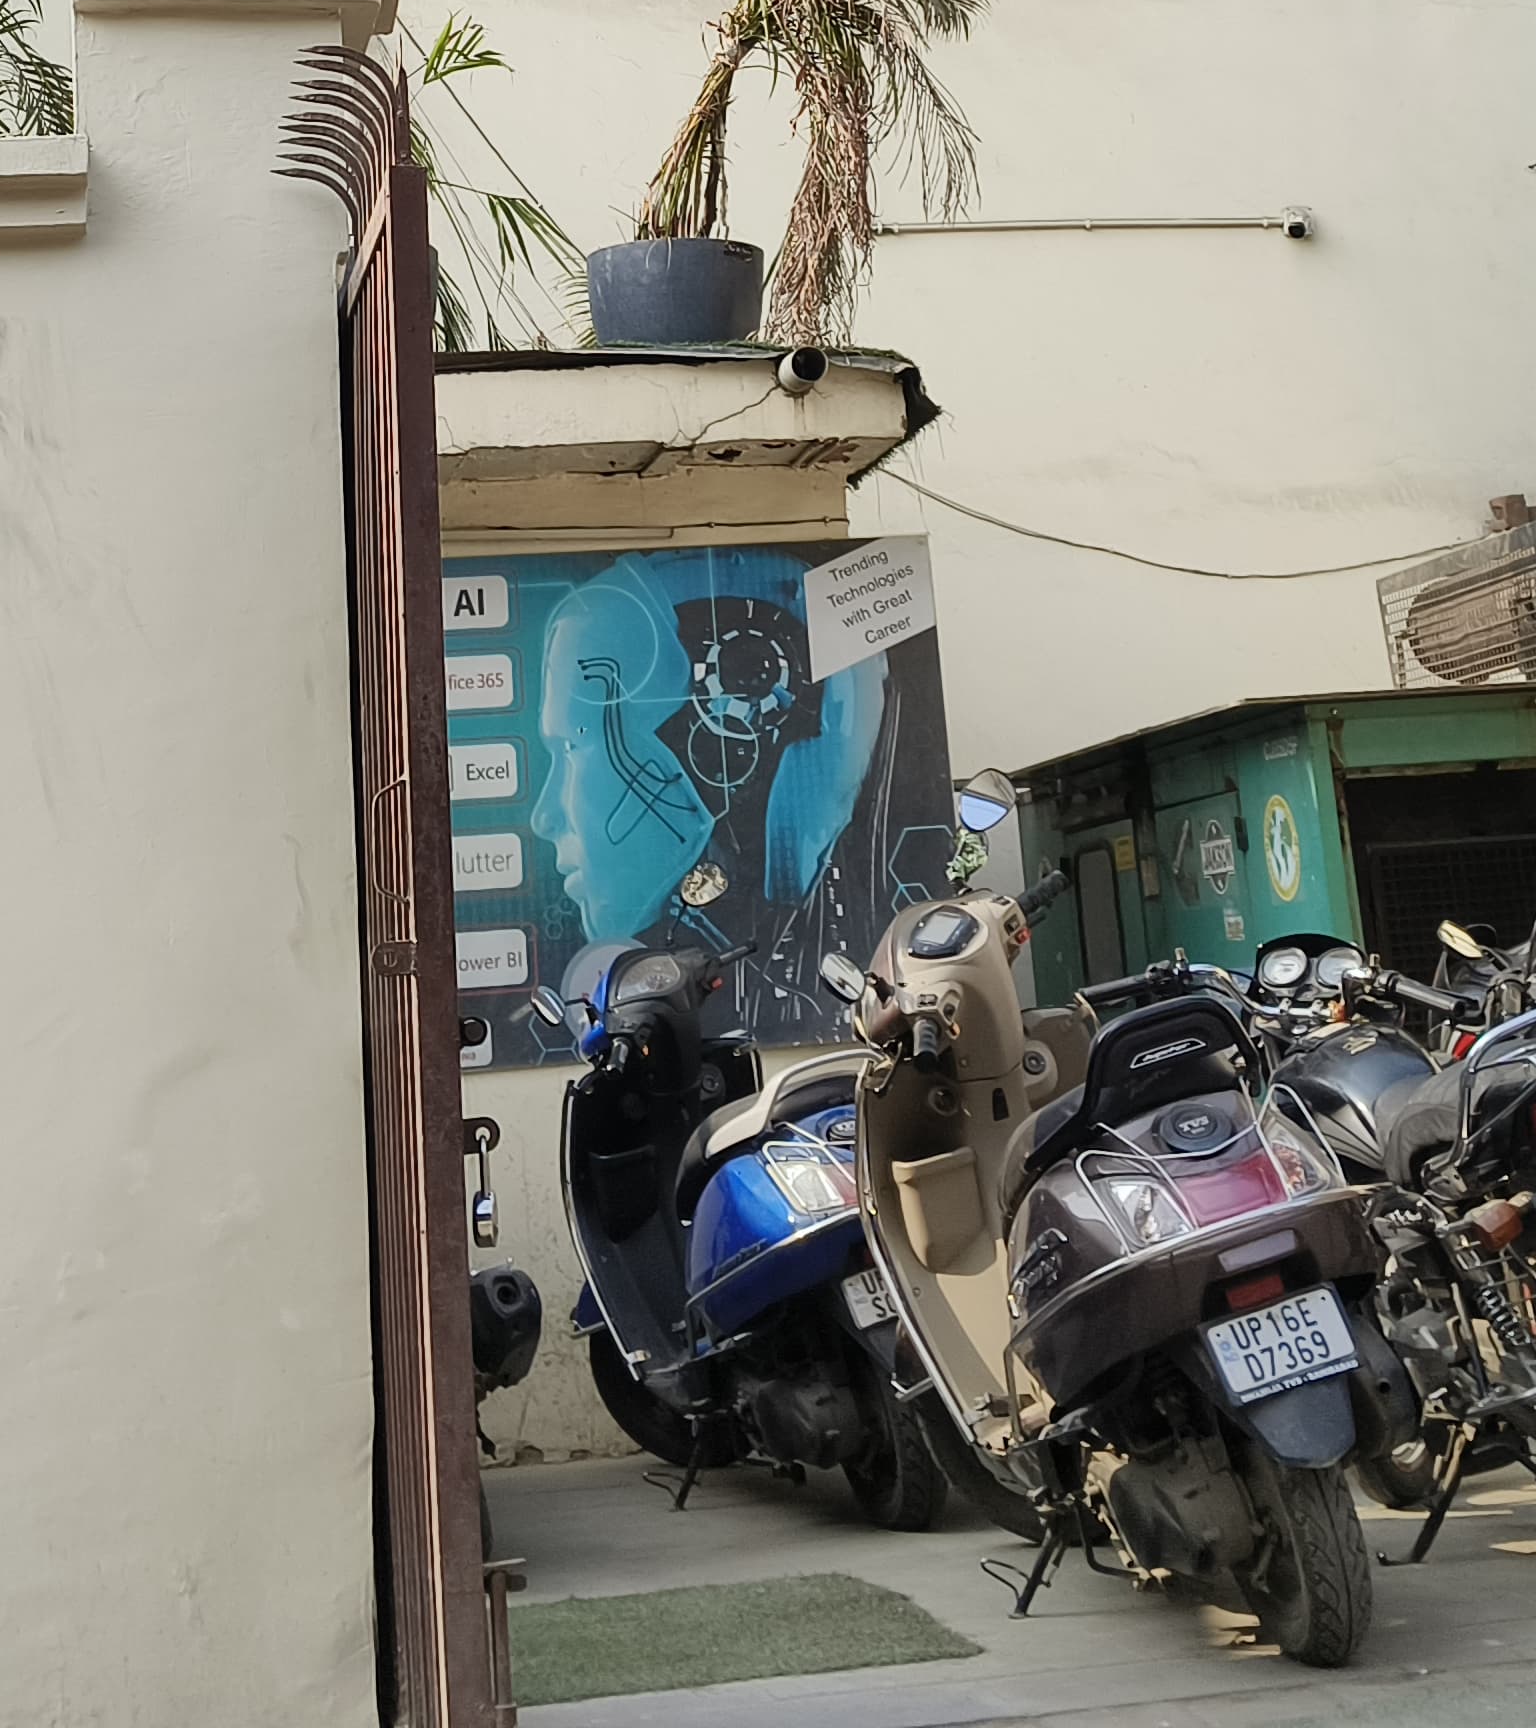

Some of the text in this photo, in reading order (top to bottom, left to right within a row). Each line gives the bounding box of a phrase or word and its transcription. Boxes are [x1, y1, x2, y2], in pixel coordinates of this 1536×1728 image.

[827, 548, 889, 583] Trending
[826, 562, 914, 610] Technologies
[453, 588, 485, 617] AI
[841, 589, 913, 630] with Great
[864, 614, 913, 645] Career
[476, 672, 505, 689] 365
[465, 759, 510, 782] Excel
[455, 850, 515, 875] lutter
[458, 951, 523, 972] ower BI
[1243, 1330, 1331, 1384] D7369
